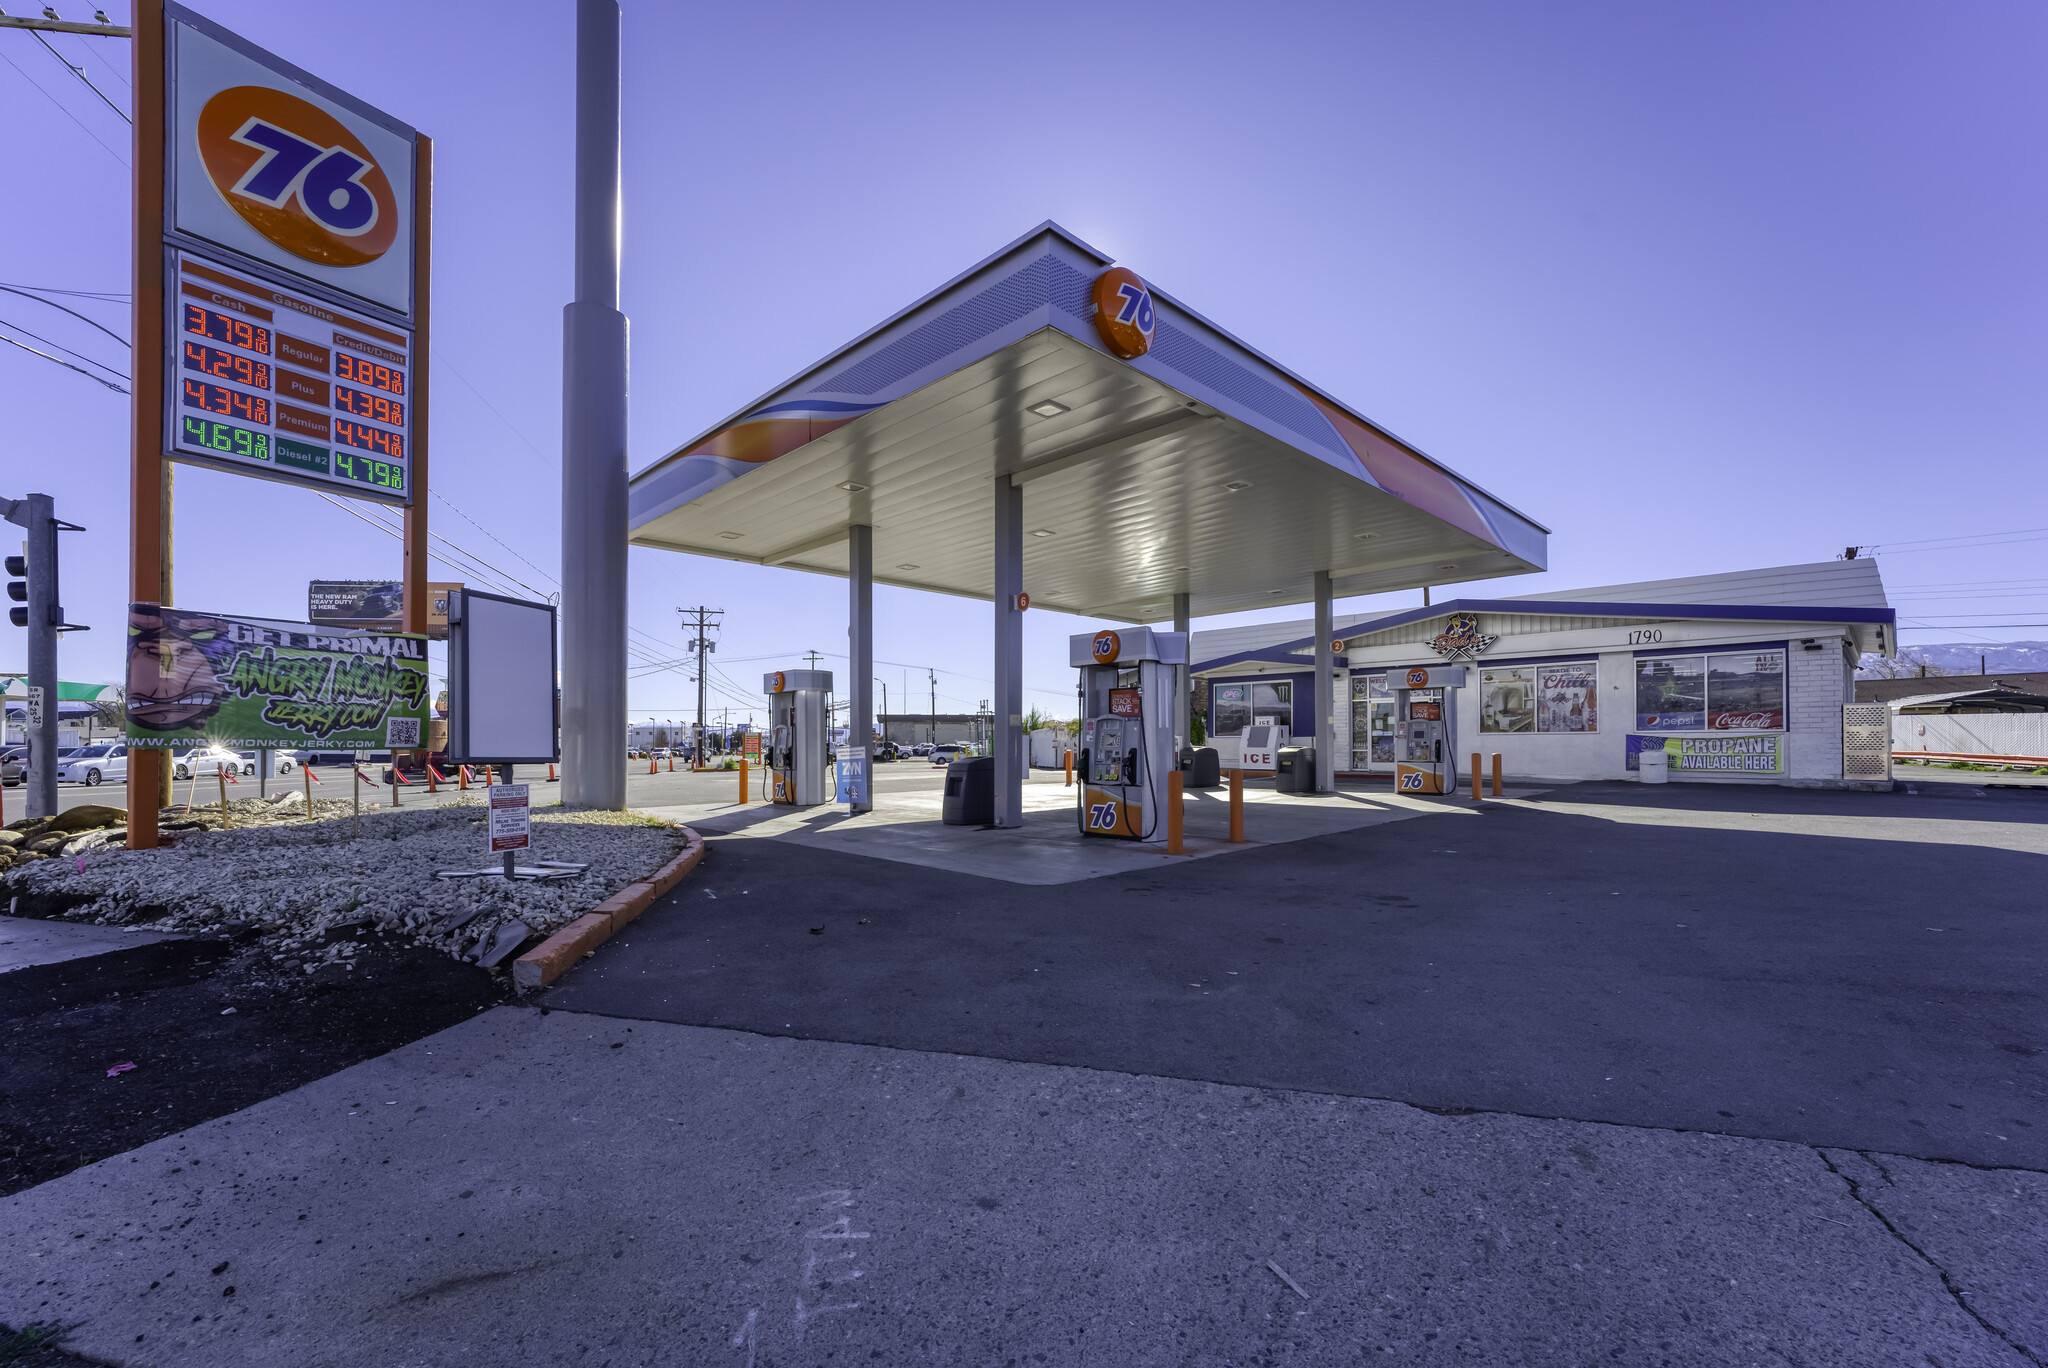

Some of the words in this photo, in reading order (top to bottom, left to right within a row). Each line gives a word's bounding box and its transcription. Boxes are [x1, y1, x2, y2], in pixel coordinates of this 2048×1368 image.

[229, 115, 378, 237] 76
[212, 294, 246, 312] Cash
[272, 293, 334, 322] Gasoline
[1115, 283, 1154, 335] 76
[282, 344, 324, 364] Regular
[336, 335, 404, 364] Credit/Debit
[292, 381, 315, 395] Plus
[280, 412, 328, 432] Premium
[278, 447, 311, 463] Diesel
[315, 453, 328, 465] #2
[228, 624, 291, 646] GET
[308, 635, 423, 659] PRIMAL
[1096, 636, 1112, 655] 76
[1436, 630, 1480, 650] Dad's
[1629, 629, 1662, 644] 1790
[223, 655, 330, 700] ANGRY
[334, 656, 426, 708] MONKEY
[1410, 673, 1423, 684] 76
[1543, 673, 1591, 689] Chill
[1663, 716, 1694, 726] pepsi
[1716, 712, 1774, 728] Coca-Cola
[1681, 737, 1776, 754] PROPANE
[842, 761, 861, 775] ZYN
[1244, 754, 1270, 764] ICE
[1681, 755, 1742, 770] AVAILABLE
[1745, 755, 1776, 771] HERE
[775, 781, 785, 798] 76
[1401, 772, 1423, 789] 76
[1090, 802, 1117, 829] 76
